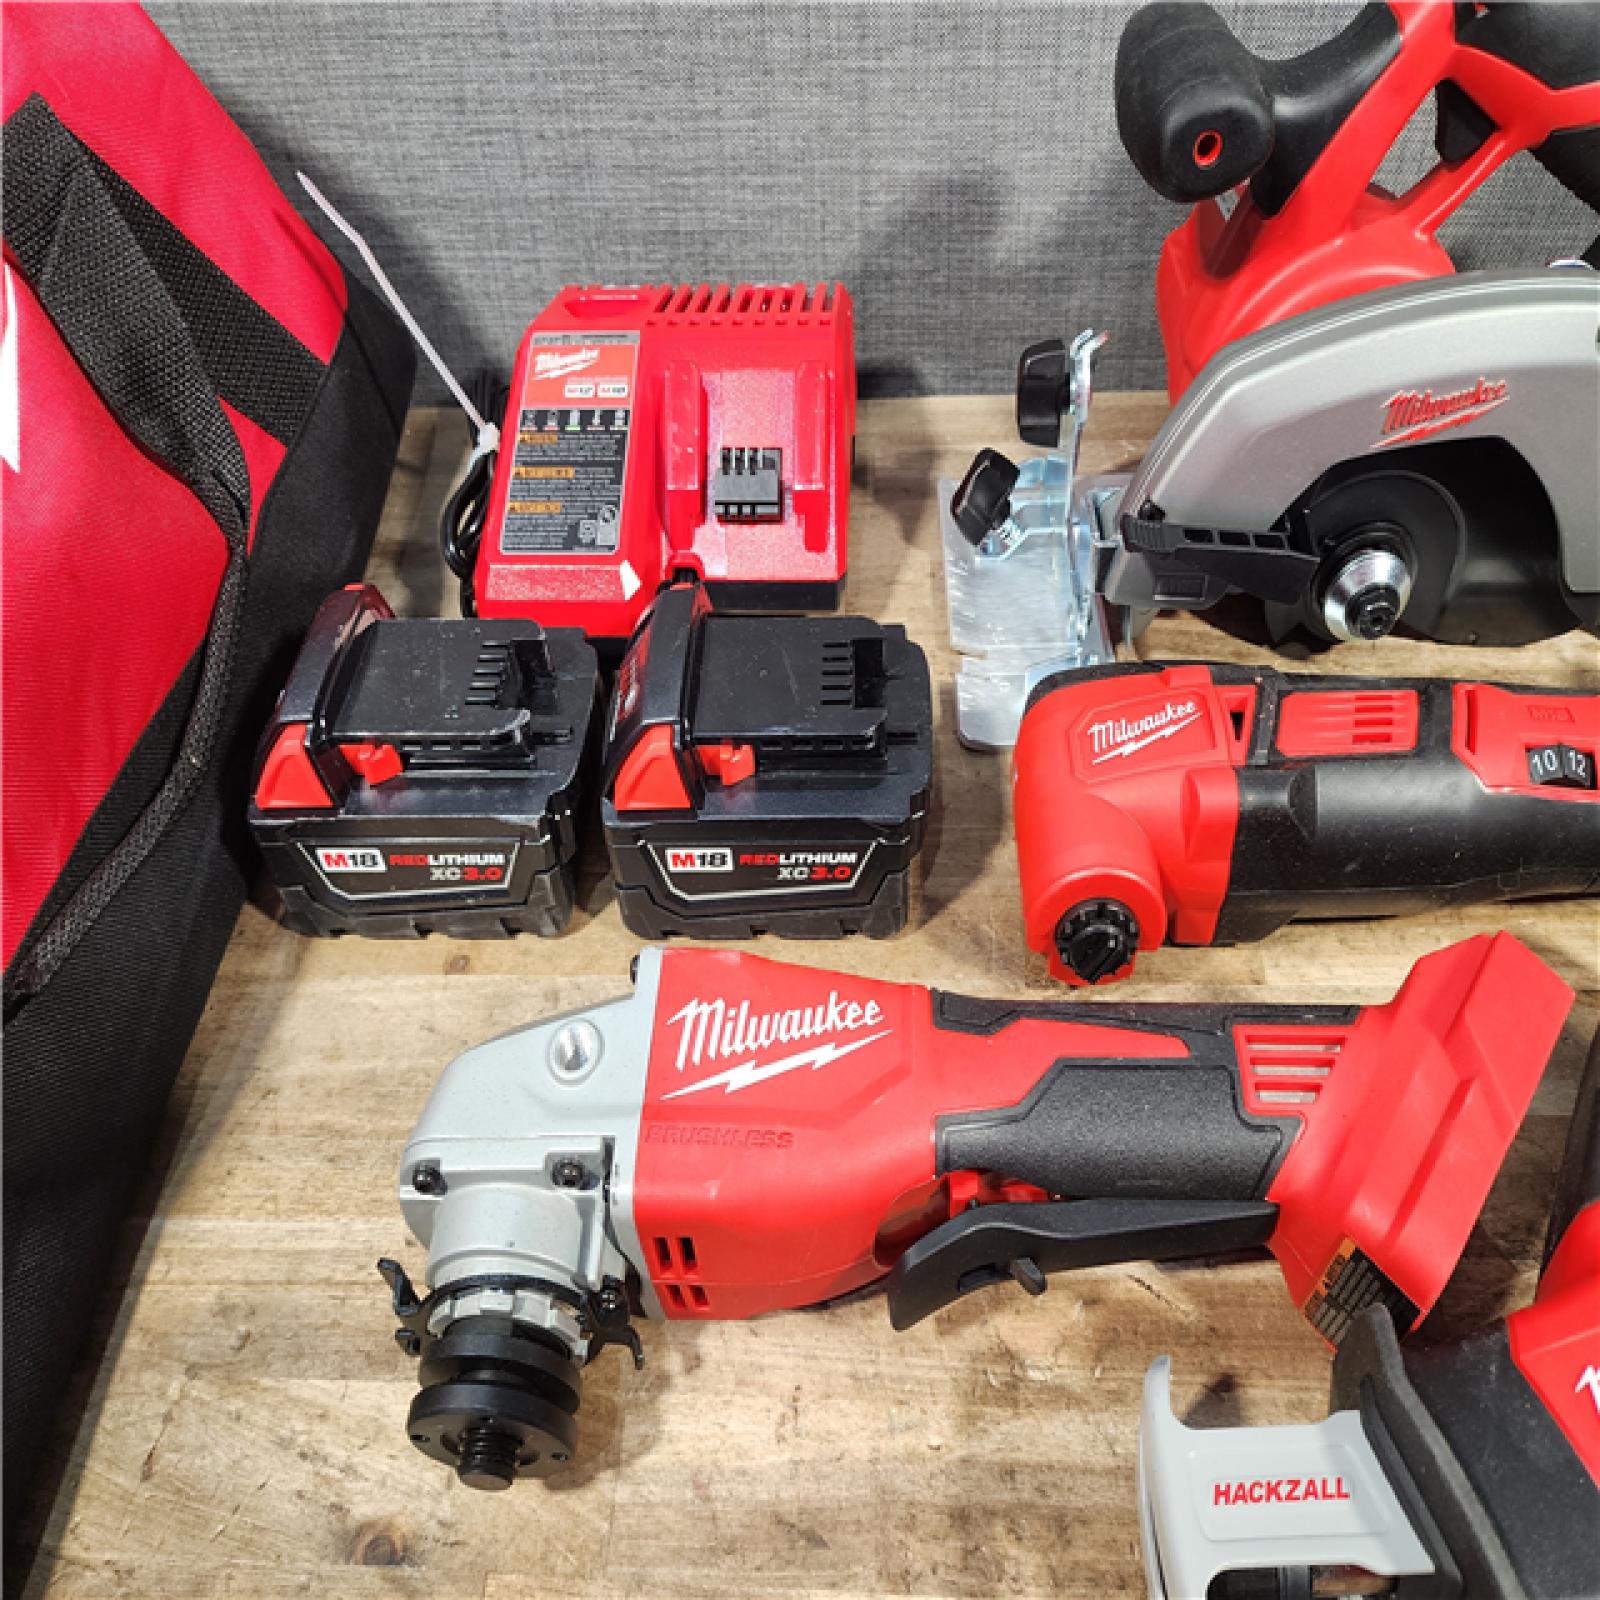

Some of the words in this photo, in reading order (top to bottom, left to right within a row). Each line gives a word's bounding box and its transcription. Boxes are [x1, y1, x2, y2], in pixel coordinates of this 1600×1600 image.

[1380, 376, 1510, 434] Milwaukee
[1087, 701, 1197, 752] Milwaukee
[1532, 749, 1558, 775] 10
[1569, 749, 1586, 777] 12
[322, 851, 379, 869] M18
[389, 854, 506, 867] REDLITHIUM
[670, 851, 728, 869] M18
[739, 852, 858, 866] REDLITHIUM
[666, 990, 886, 1072] Milwaukee
[645, 1124, 794, 1148] BRUSHLESS
[1213, 1476, 1350, 1506] HACKZALL
